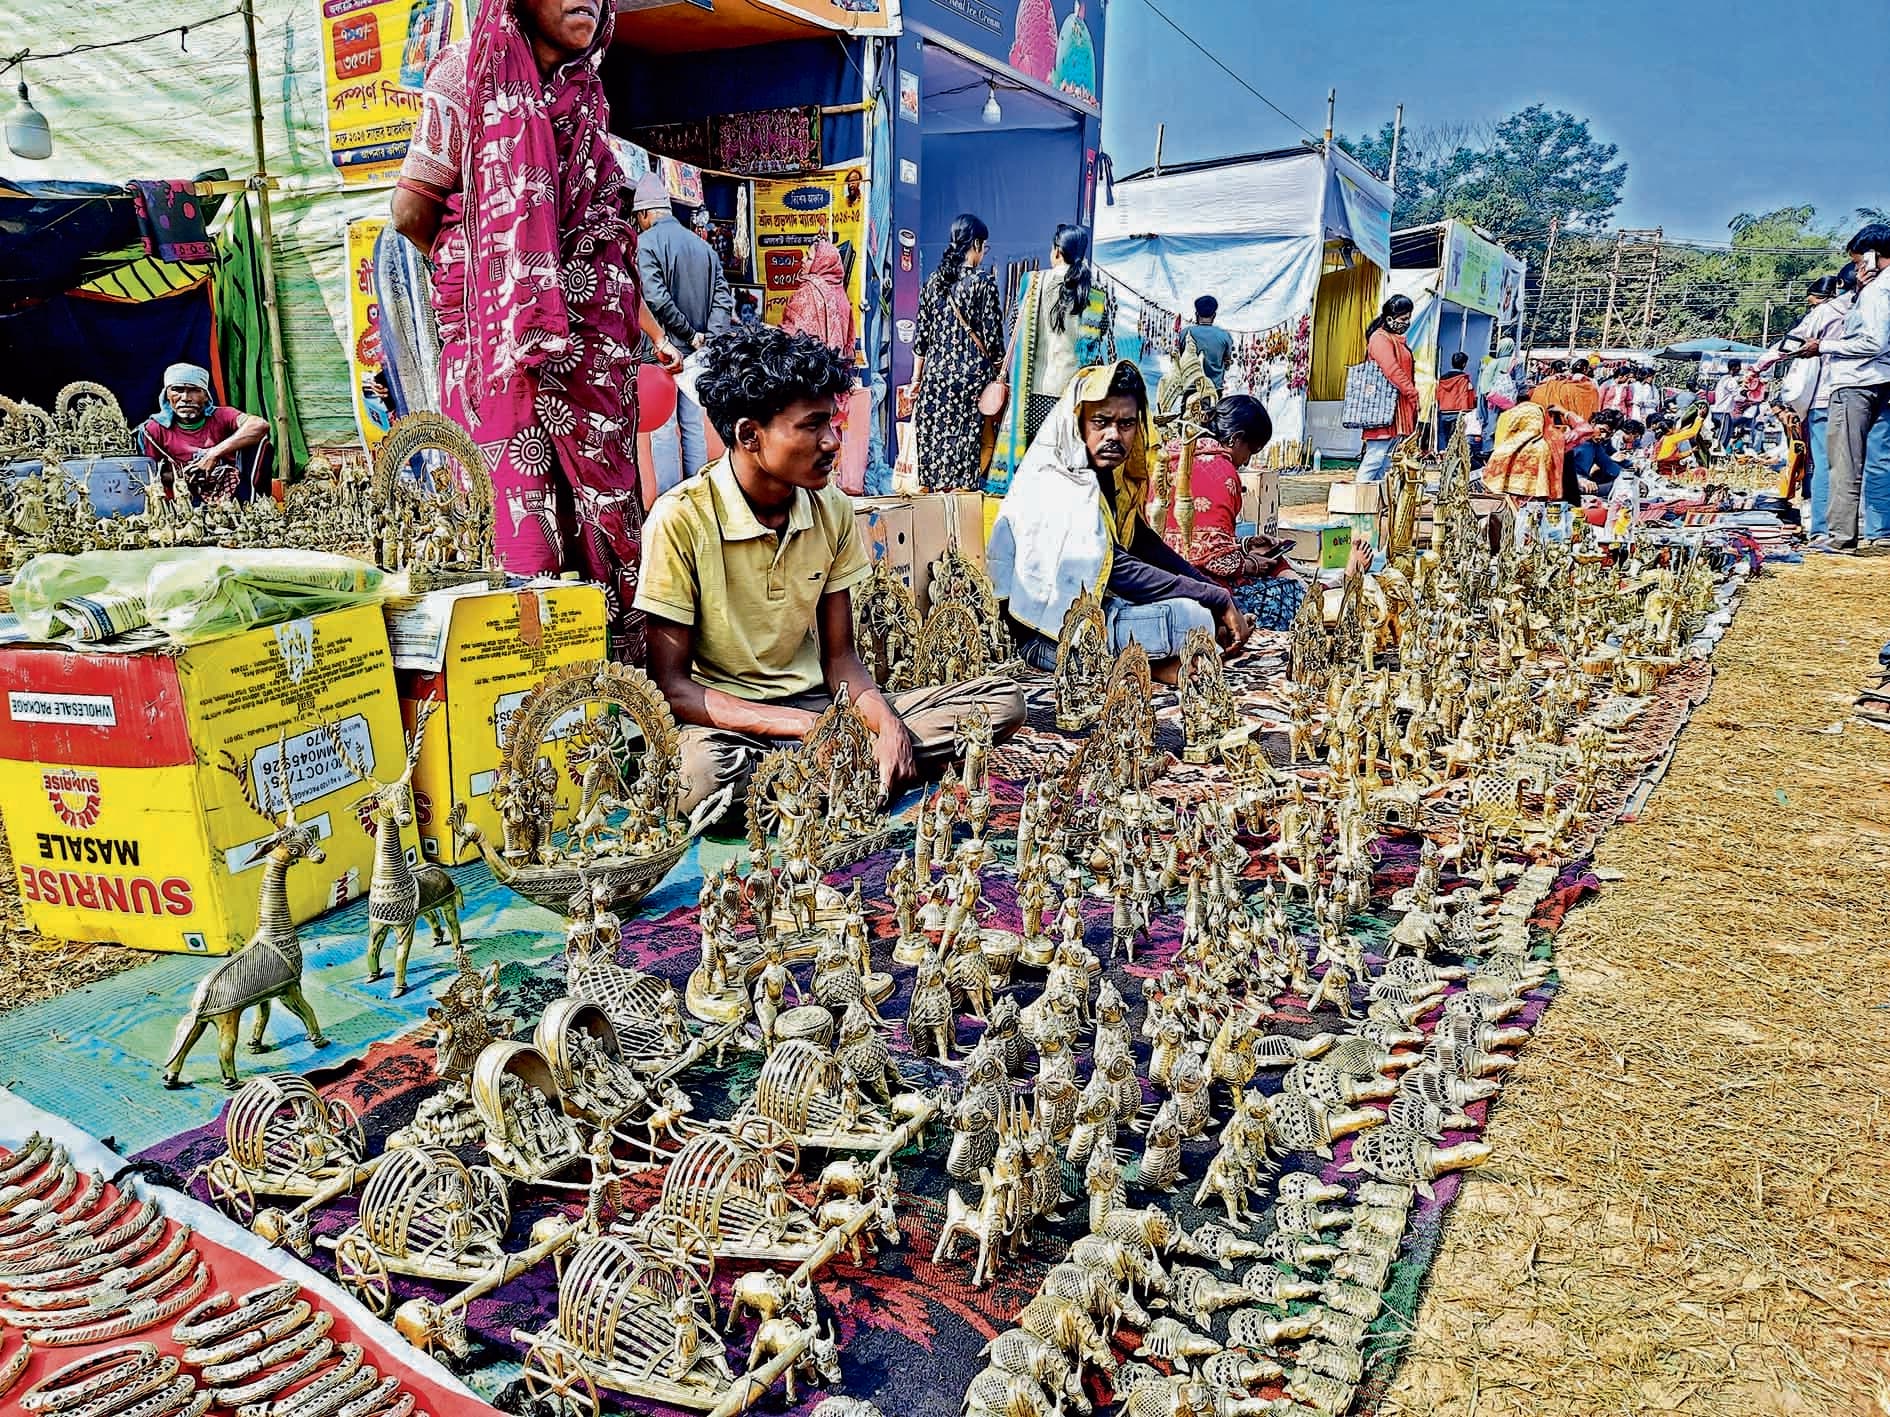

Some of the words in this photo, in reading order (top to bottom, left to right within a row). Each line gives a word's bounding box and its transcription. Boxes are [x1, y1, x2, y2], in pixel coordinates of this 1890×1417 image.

[967, 3, 977, 17] Ice
[12, 699, 52, 713] PACKAGE
[55, 701, 114, 718] WHOLESALE
[263, 738, 351, 775] AMM045S26
[43, 775, 100, 793] SUNRISE
[271, 758, 342, 788] 10/OCT/5
[37, 832, 140, 866] MASALE
[21, 865, 195, 917] SUNRISE
